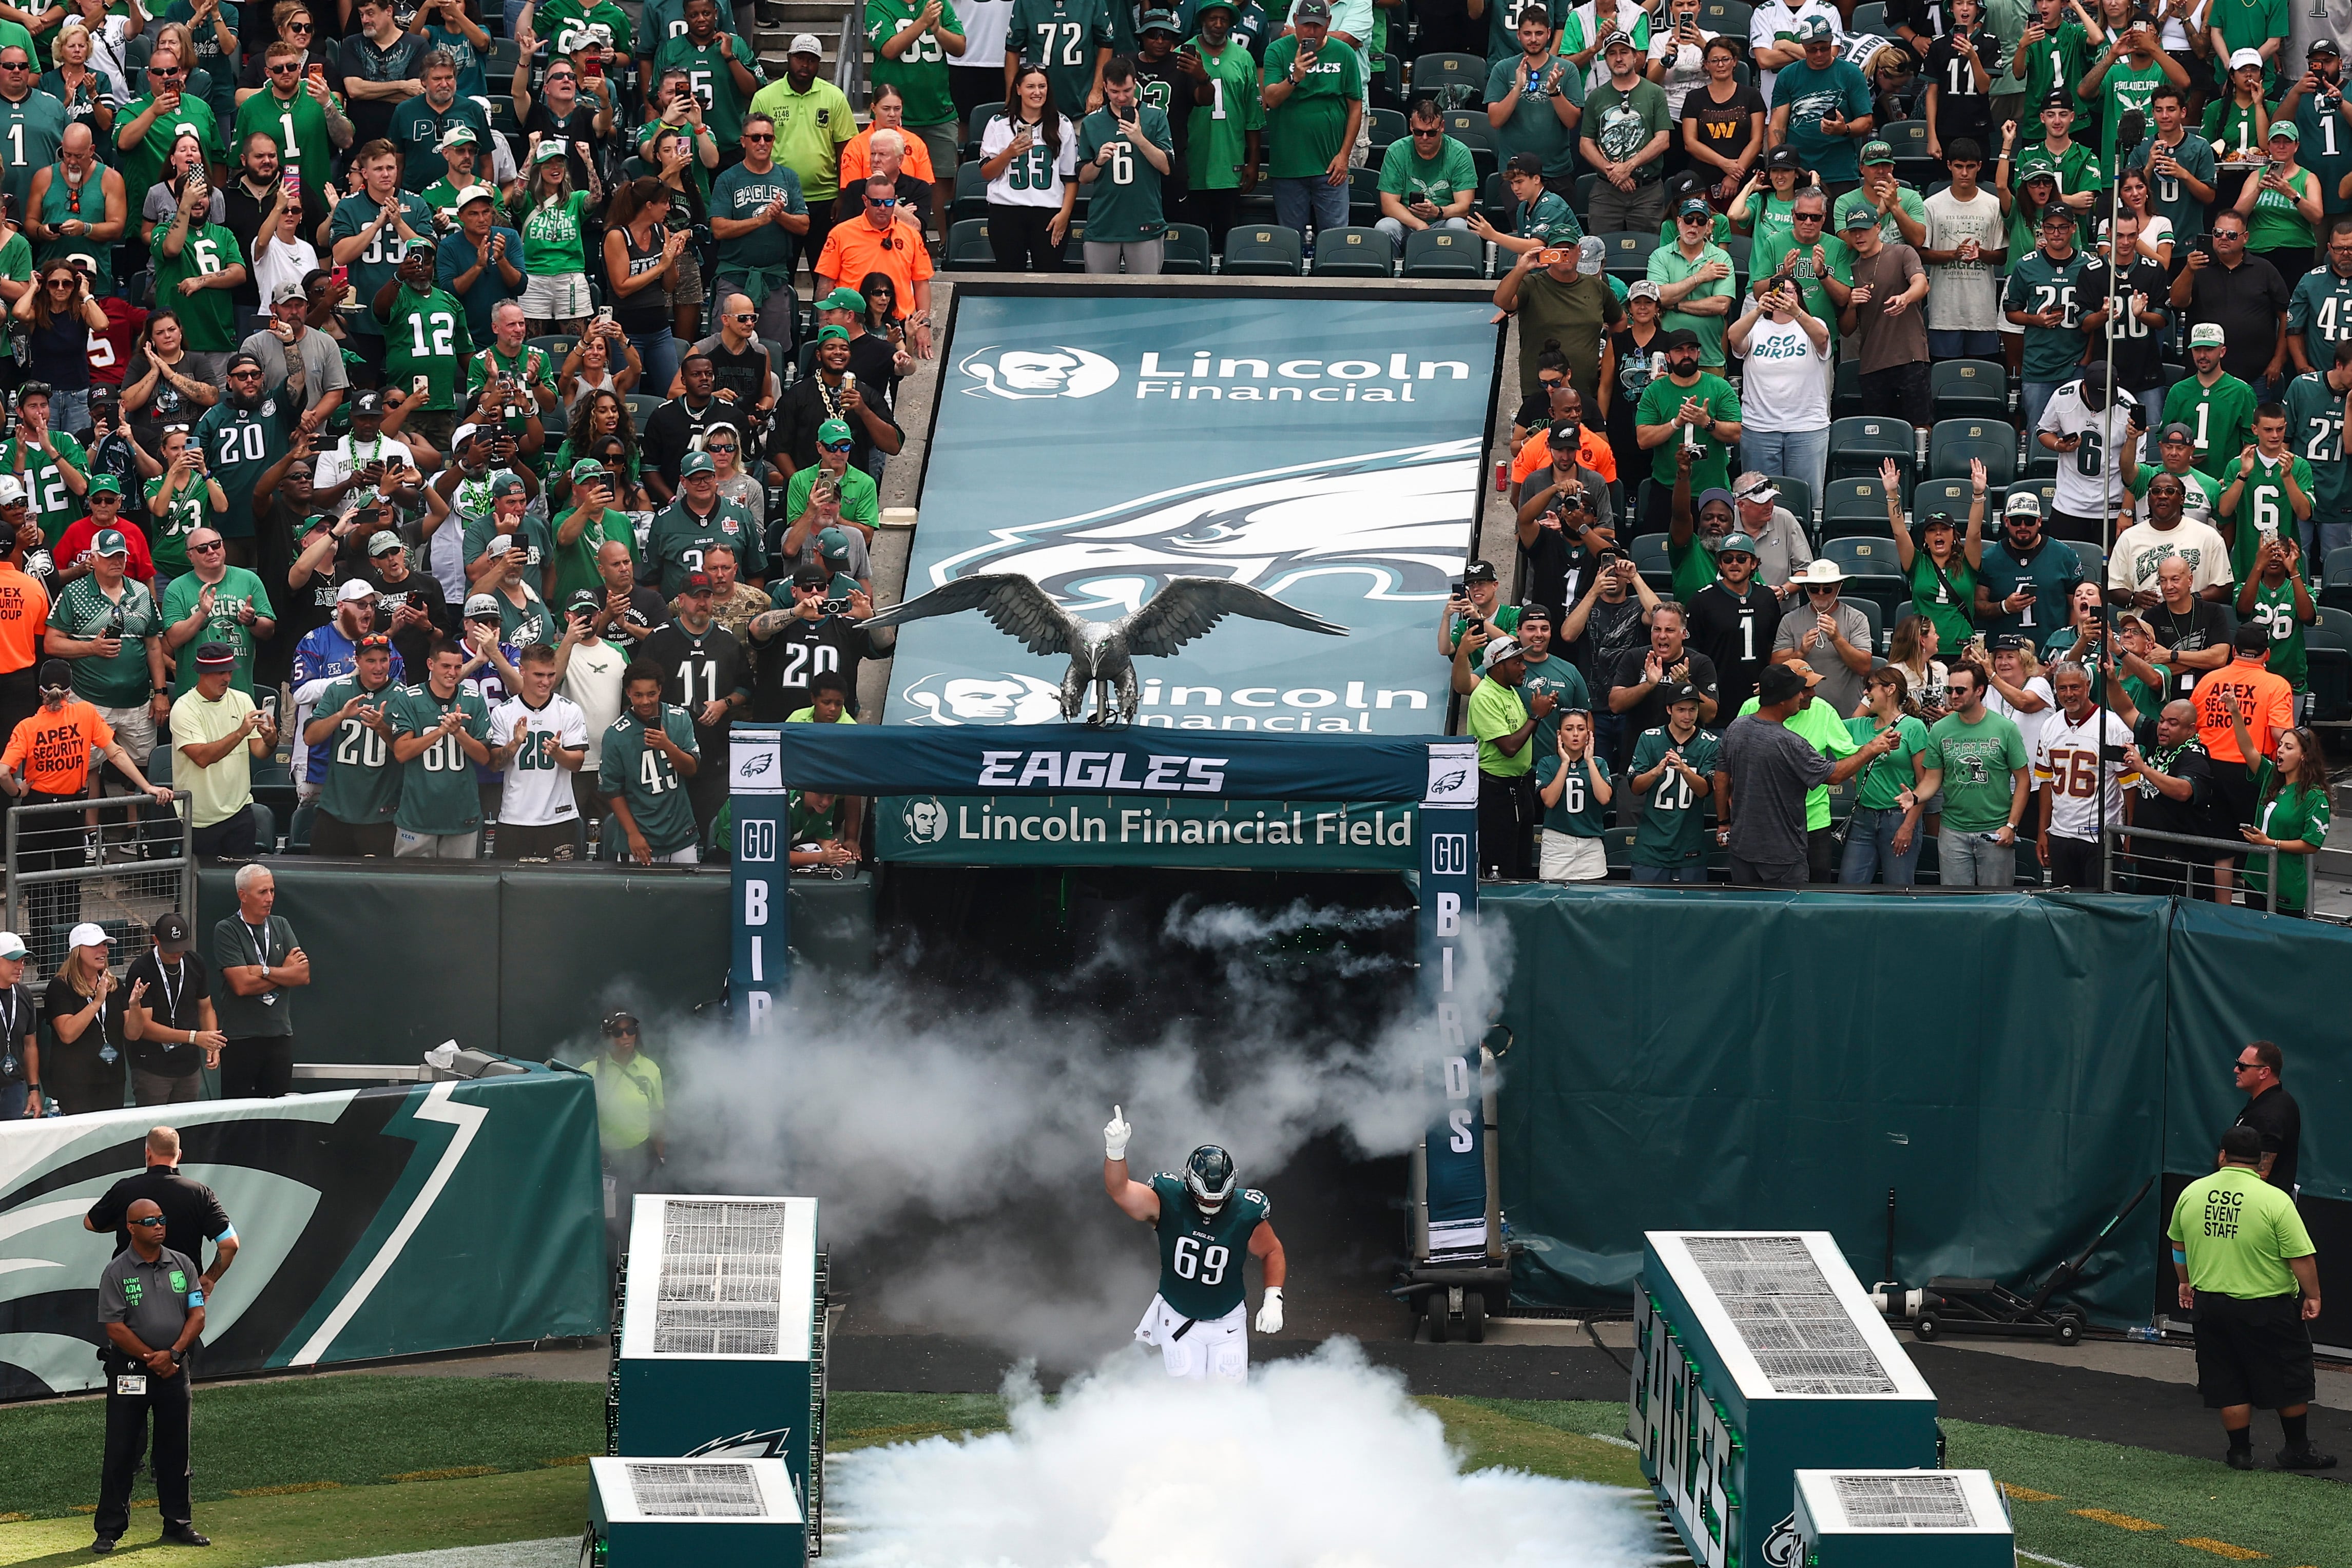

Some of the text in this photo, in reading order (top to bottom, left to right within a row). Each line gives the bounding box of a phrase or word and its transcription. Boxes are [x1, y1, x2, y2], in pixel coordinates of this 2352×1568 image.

[1037, 22, 1083, 66] 72
[1946, 58, 1978, 95] 11
[2050, 50, 2064, 88] 1
[1210, 78, 1226, 120] 1
[7, 124, 28, 166] 1
[279, 113, 301, 159] 1
[2237, 121, 2248, 153] 1
[2319, 115, 2341, 157] 1
[1009, 144, 1053, 190] 33
[1112, 141, 1134, 185] 6
[545, 208, 566, 219] THE
[734, 185, 789, 208] EAGLES
[530, 227, 577, 241] EAGLES
[1775, 214, 1794, 223] BIR
[194, 239, 221, 276] 6
[361, 221, 406, 264] 33
[1941, 259, 1987, 271] EAGLES
[2035, 285, 2079, 329] 26
[2317, 297, 2352, 341] 43
[87, 336, 116, 368] 5
[407, 311, 455, 358] 12
[1753, 342, 1806, 359] BIRDS
[1767, 334, 1796, 347] GO
[1139, 350, 1470, 380] Lincoln
[1135, 380, 1416, 402] Financial
[219, 423, 265, 464] 20
[2193, 401, 2210, 450] 1
[2307, 418, 2345, 463] 27
[2077, 430, 2103, 477] 6
[24, 464, 70, 514] 12
[2254, 485, 2280, 531] 6
[527, 552, 541, 566] LES
[2136, 542, 2174, 567] FLY
[0, 588, 22, 597] PEX
[0, 599, 24, 609] URITY
[382, 592, 407, 606] EAGLE
[1561, 568, 1580, 608] 1
[0, 610, 22, 621] OUP
[190, 597, 246, 619] EGLES
[628, 609, 648, 626] EAGLES
[1739, 616, 1756, 662] 1
[294, 665, 304, 681] 5
[676, 660, 717, 706] 11
[782, 642, 839, 688] 20
[1087, 678, 1429, 709] Lincoln
[35, 723, 82, 746] APEX
[1088, 710, 1373, 733] nancial
[33, 738, 84, 761] SECURITY
[337, 718, 387, 767] 20
[422, 725, 466, 771] 80
[1942, 738, 2000, 760] EAGLES
[35, 754, 84, 773] GROUP
[640, 749, 679, 796] 43
[977, 750, 1229, 793] EAGLES
[2049, 748, 2098, 799] 56
[1565, 777, 1585, 814] 6
[744, 822, 773, 859] GO
[958, 804, 1413, 847] Lincoln Financial Field
[1435, 837, 1465, 871] GO
[745, 879, 773, 1036] BIR
[1437, 892, 1474, 1153] BIRDS
[2204, 1205, 2241, 1224] EVENT
[2207, 1190, 2244, 1206] CSC
[1192, 1230, 1216, 1242] EAGLES
[2204, 1222, 2239, 1240] STAFF
[1173, 1236, 1230, 1286] 69
[123, 1277, 140, 1285] EVENT
[125, 1284, 142, 1294] 4014
[126, 1293, 143, 1302] STAFF
[1628, 1278, 1733, 1568] EAGLES
